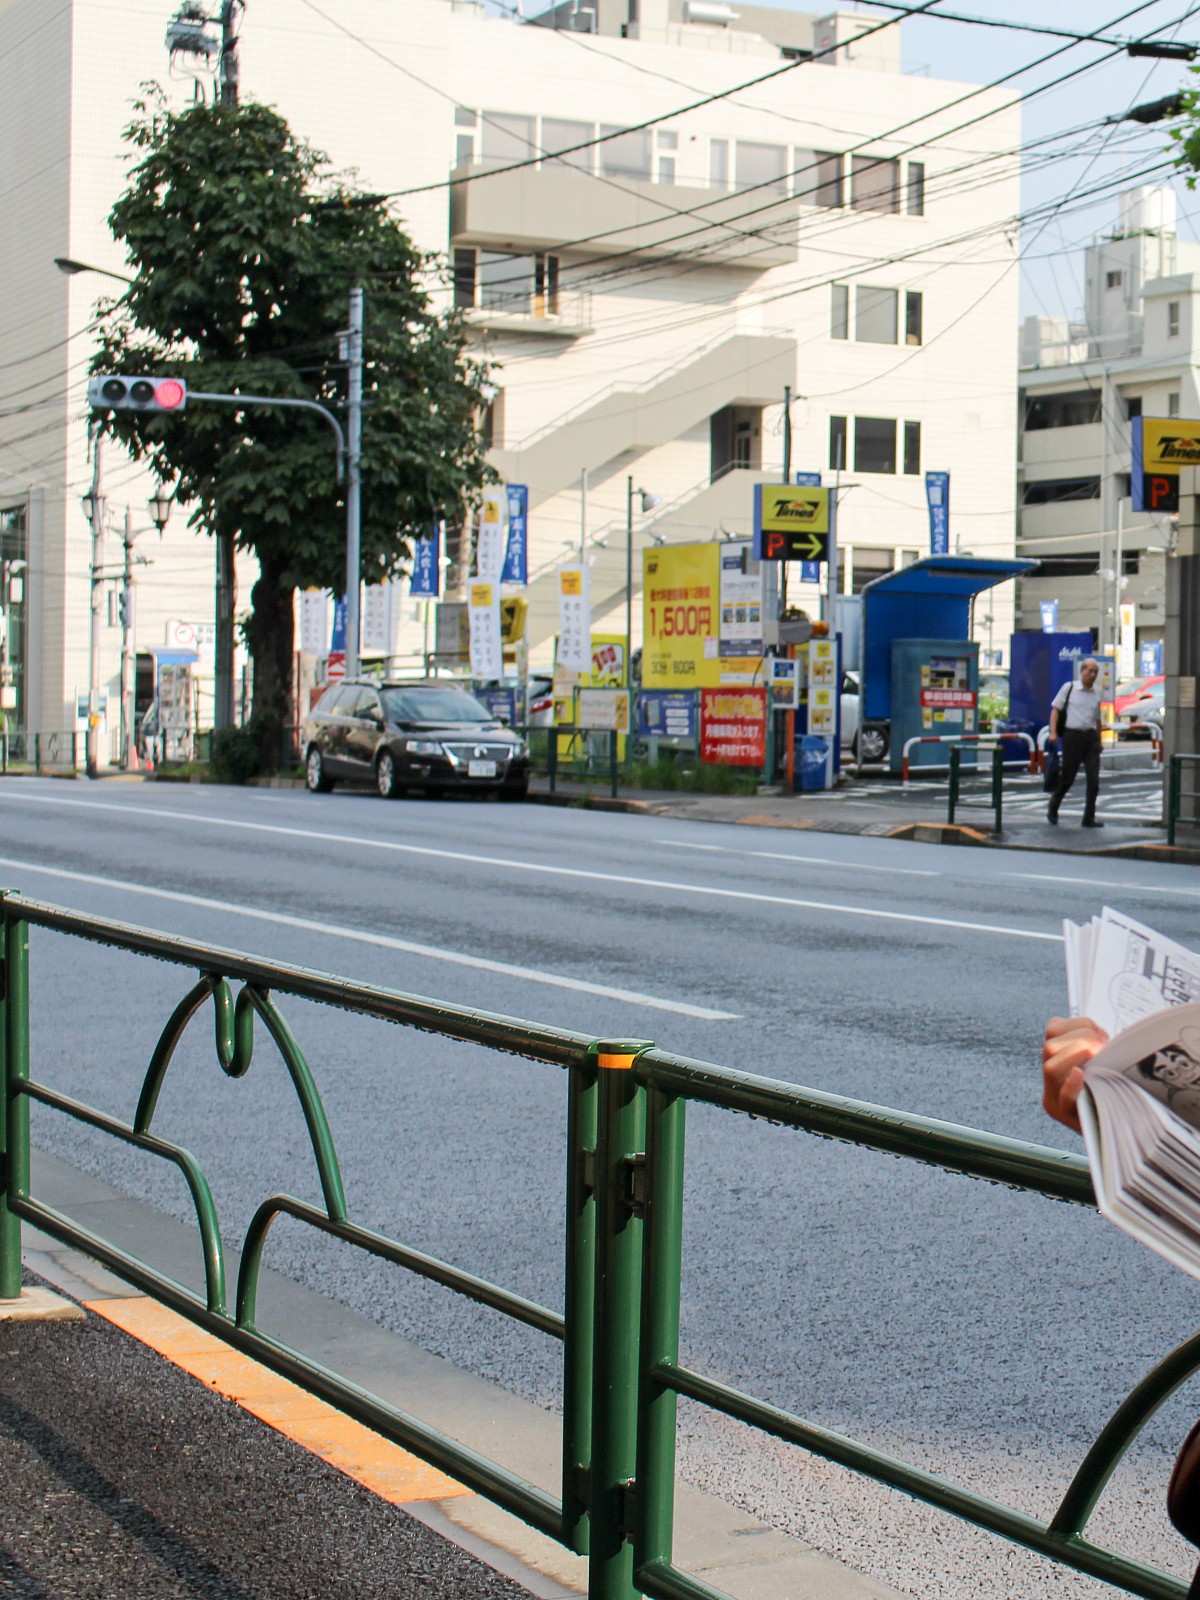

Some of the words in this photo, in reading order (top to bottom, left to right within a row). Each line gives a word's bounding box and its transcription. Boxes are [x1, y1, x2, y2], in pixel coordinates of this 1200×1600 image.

[1151, 477, 1170, 508] P
[774, 499, 820, 518] Times
[767, 533, 785, 558] P
[650, 604, 711, 640] 1,500円
